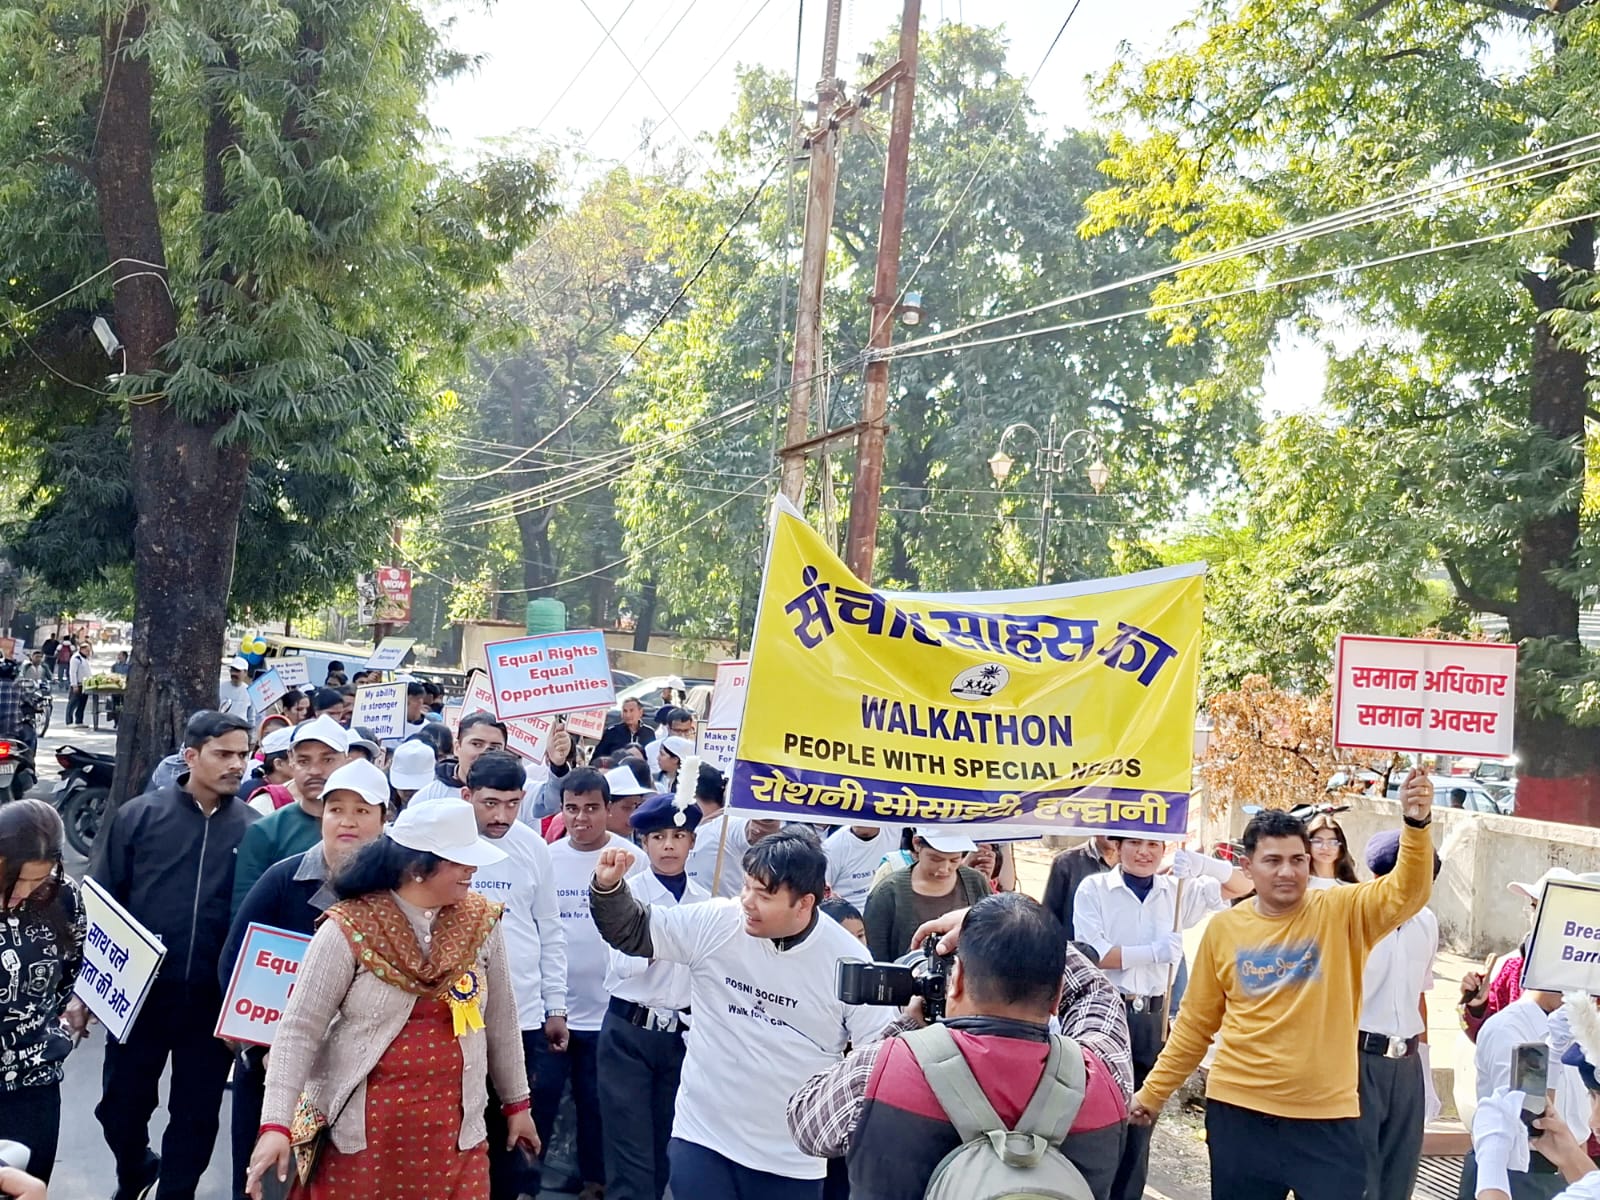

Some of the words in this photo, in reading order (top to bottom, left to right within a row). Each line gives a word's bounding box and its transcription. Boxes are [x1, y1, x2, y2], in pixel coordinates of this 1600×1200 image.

[499, 650, 543, 667] Equal
[548, 645, 598, 661] Rights
[1097, 621, 1178, 687] का
[529, 664, 574, 680] Equal
[733, 677, 745, 687] Di
[1351, 667, 1418, 691] समान
[1424, 665, 1508, 696] अधिकार
[365, 690, 374, 699] My
[376, 688, 396, 698] ability
[501, 678, 608, 702] Opportunities
[364, 713, 380, 722] than
[381, 714, 392, 722] my
[369, 701, 398, 711] stronger
[861, 695, 1073, 747] WALKATHON
[1357, 704, 1424, 729] समान
[1429, 709, 1498, 734] अवसर
[704, 732, 728, 741] Make
[704, 743, 724, 753] Easy
[784, 733, 876, 767] PEOPLE
[883, 748, 946, 775] WITH
[954, 757, 1061, 780] SPECIAL
[1070, 758, 1141, 780] NEEDS
[750, 769, 868, 811] रोशनी
[1033, 793, 1170, 825] हल्द्वानी
[475, 881, 512, 890] SOCIETY
[1564, 921, 1600, 940] Brea
[87, 922, 112, 956] साथ
[109, 942, 129, 973] चले
[256, 950, 299, 975] Equ
[96, 972, 113, 1000] की
[108, 988, 131, 1019] ओर
[725, 977, 753, 994] ROSNI
[755, 988, 798, 1008] SOCIETY
[235, 998, 281, 1024] Opp
[728, 1004, 749, 1016] Walk
